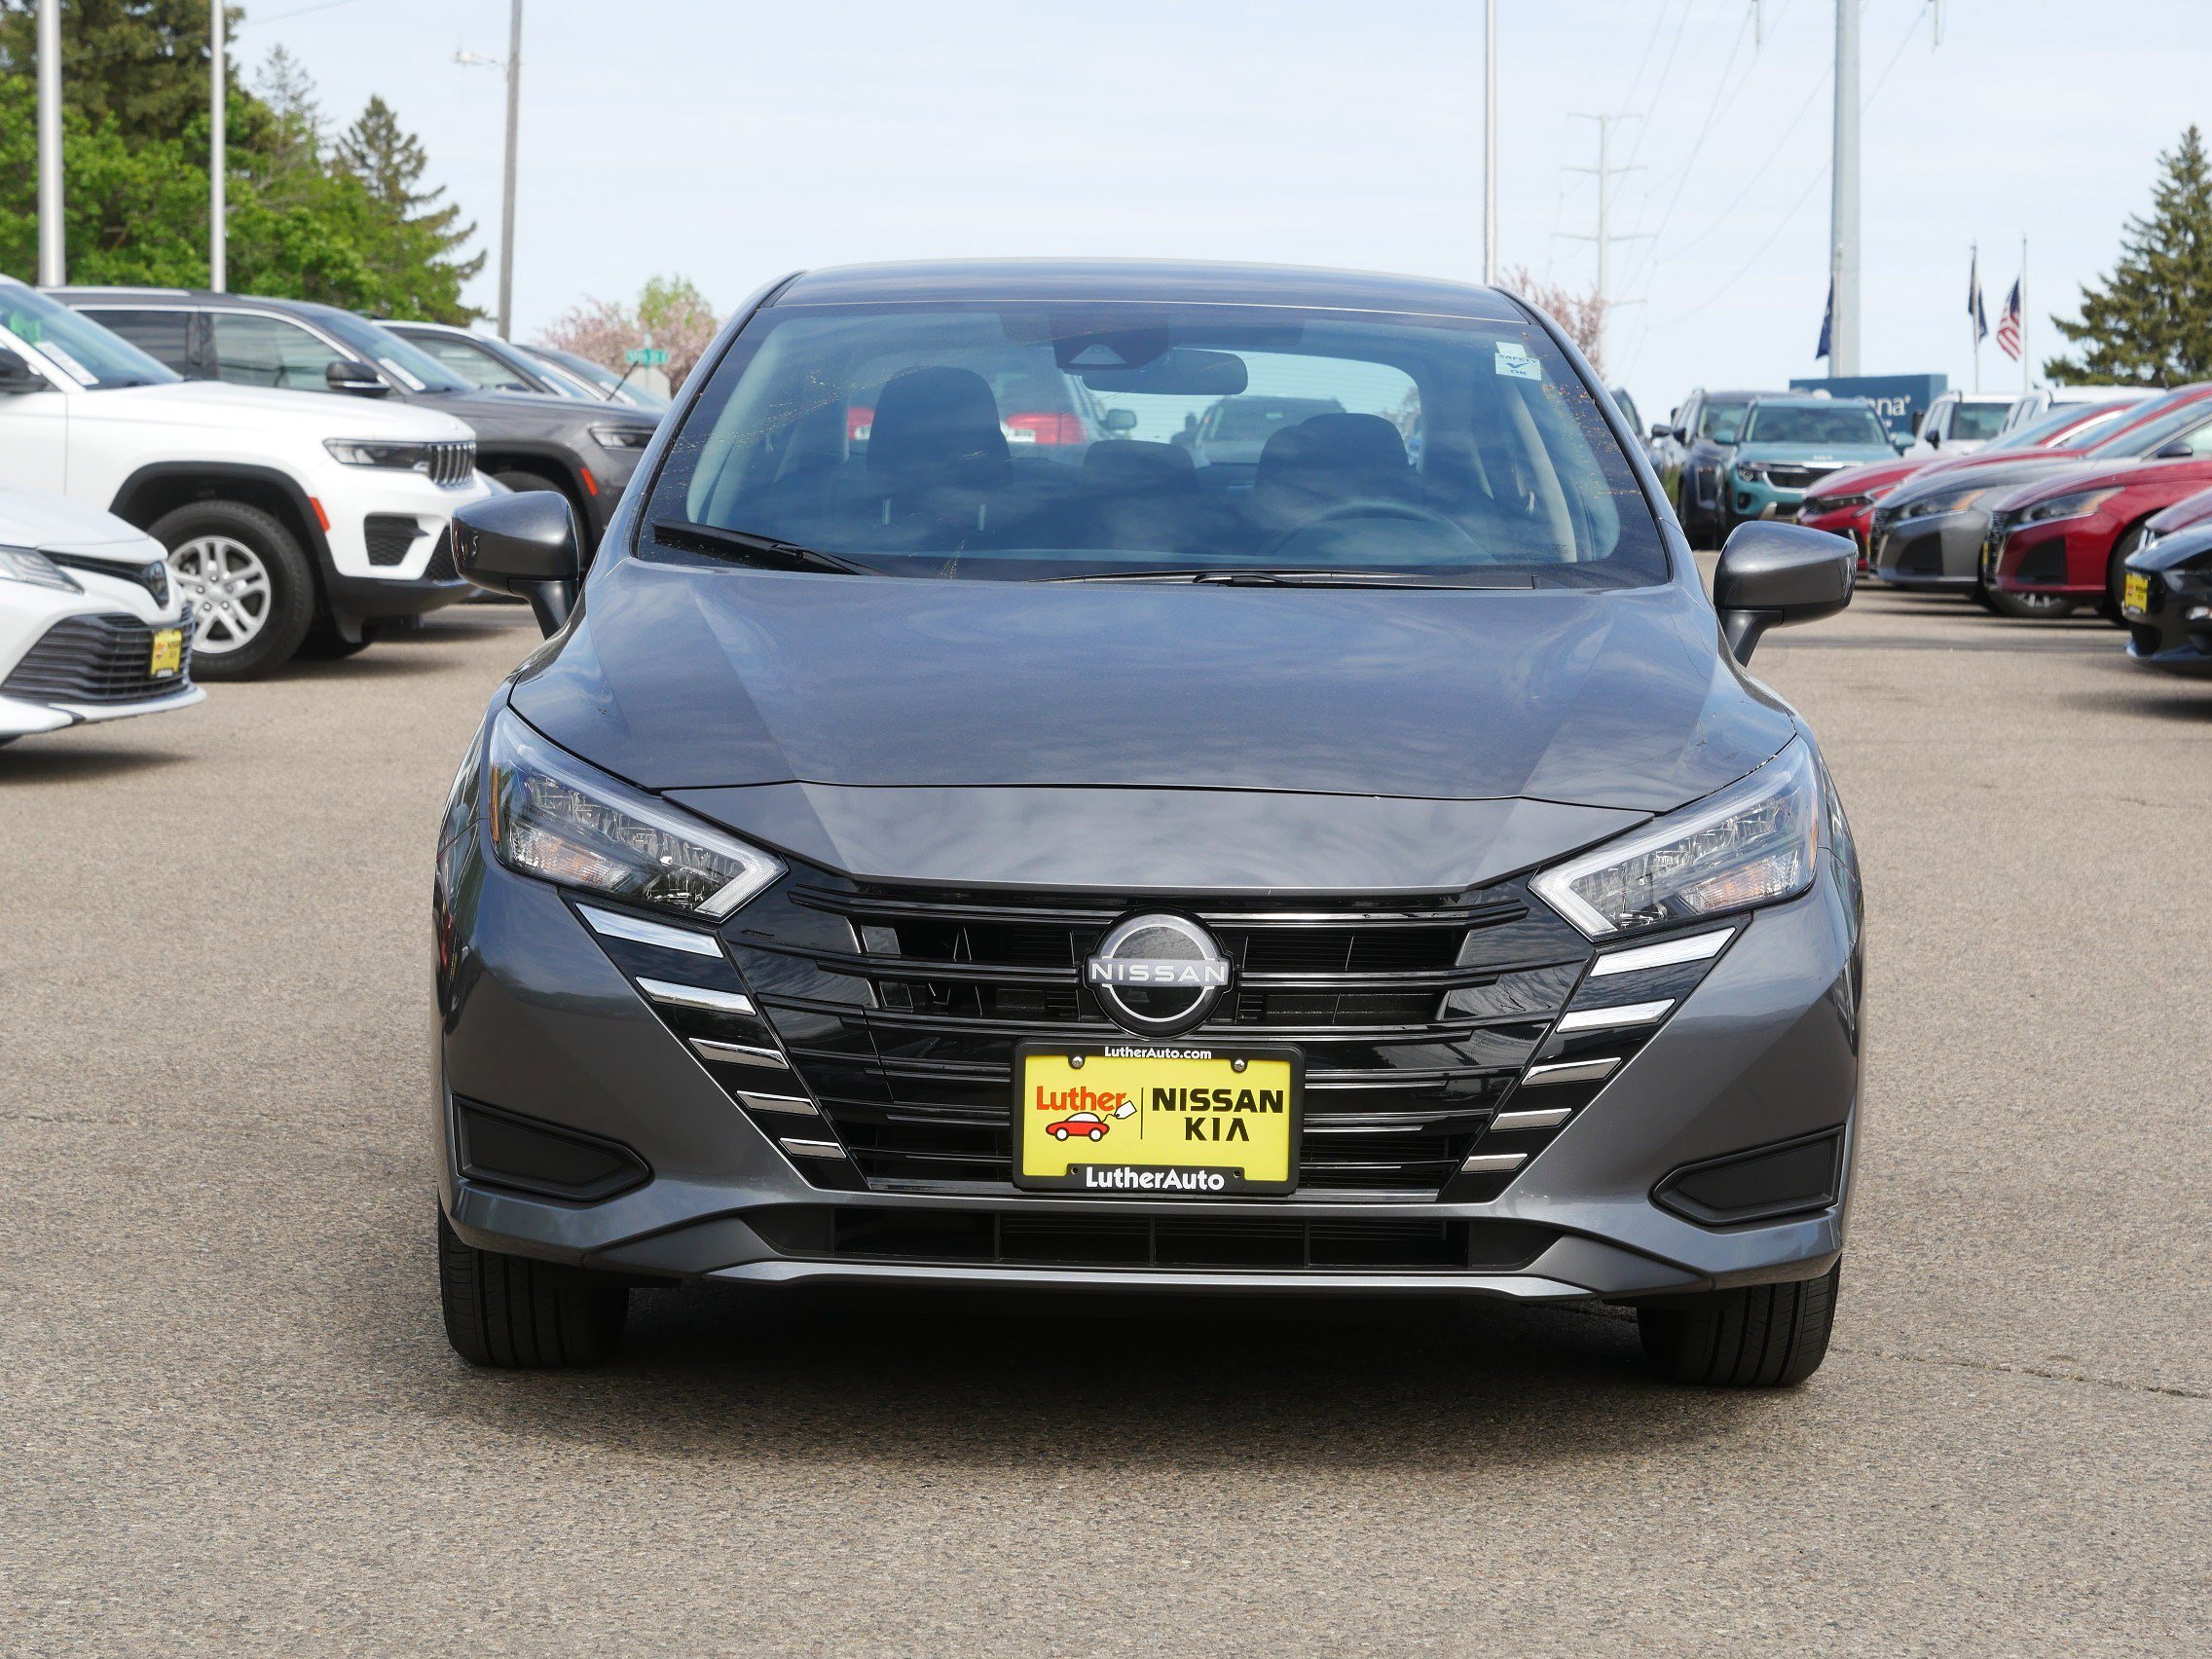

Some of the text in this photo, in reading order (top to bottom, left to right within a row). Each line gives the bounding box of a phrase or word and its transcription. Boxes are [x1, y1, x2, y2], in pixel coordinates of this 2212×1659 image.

[1091, 963, 1225, 982] NISSAN
[1104, 1046, 1212, 1059] LutherAuto.com
[1036, 1086, 1127, 1111] Luther
[1152, 1088, 1284, 1114] NISSAN
[1184, 1117, 1250, 1142] KIA
[1086, 1166, 1225, 1191] LutherAuto
